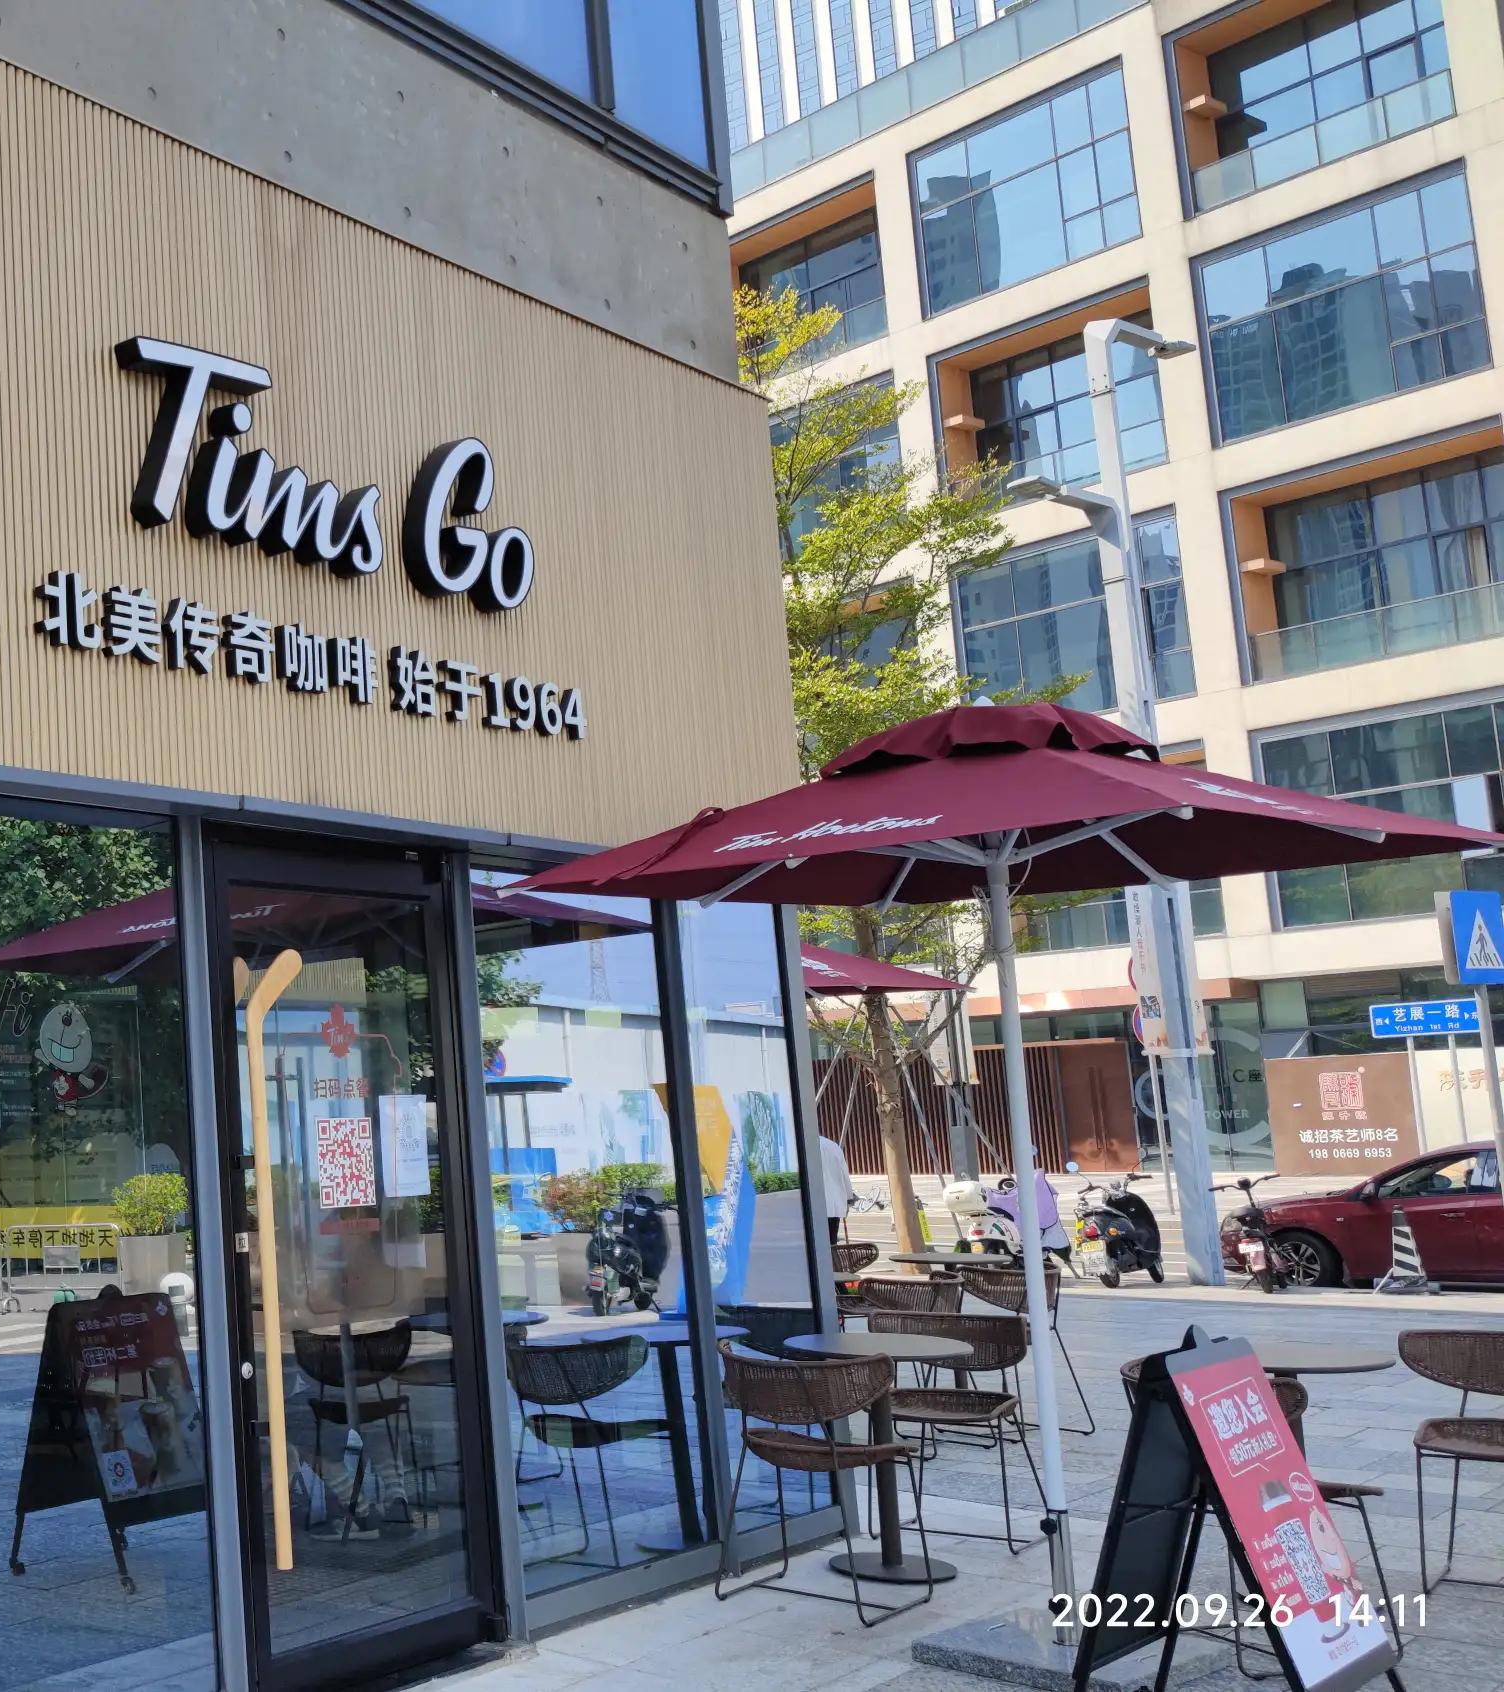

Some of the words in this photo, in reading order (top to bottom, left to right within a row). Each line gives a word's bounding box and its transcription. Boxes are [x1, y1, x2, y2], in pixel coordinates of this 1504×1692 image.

[115, 336, 384, 578] Tims
[403, 437, 534, 610] Go
[35, 570, 378, 704] 北美传奇咖啡
[391, 645, 588, 740] 始于1964
[1392, 1004, 1460, 1021] 艺展一路
[314, 1078, 370, 1099] 扫码点餐
[1299, 1128, 1399, 1143] 诚招茶艺师8名
[1309, 1149, 1328, 1159] 198
[1333, 1148, 1360, 1158] 0669
[1365, 1147, 1392, 1158] 6953
